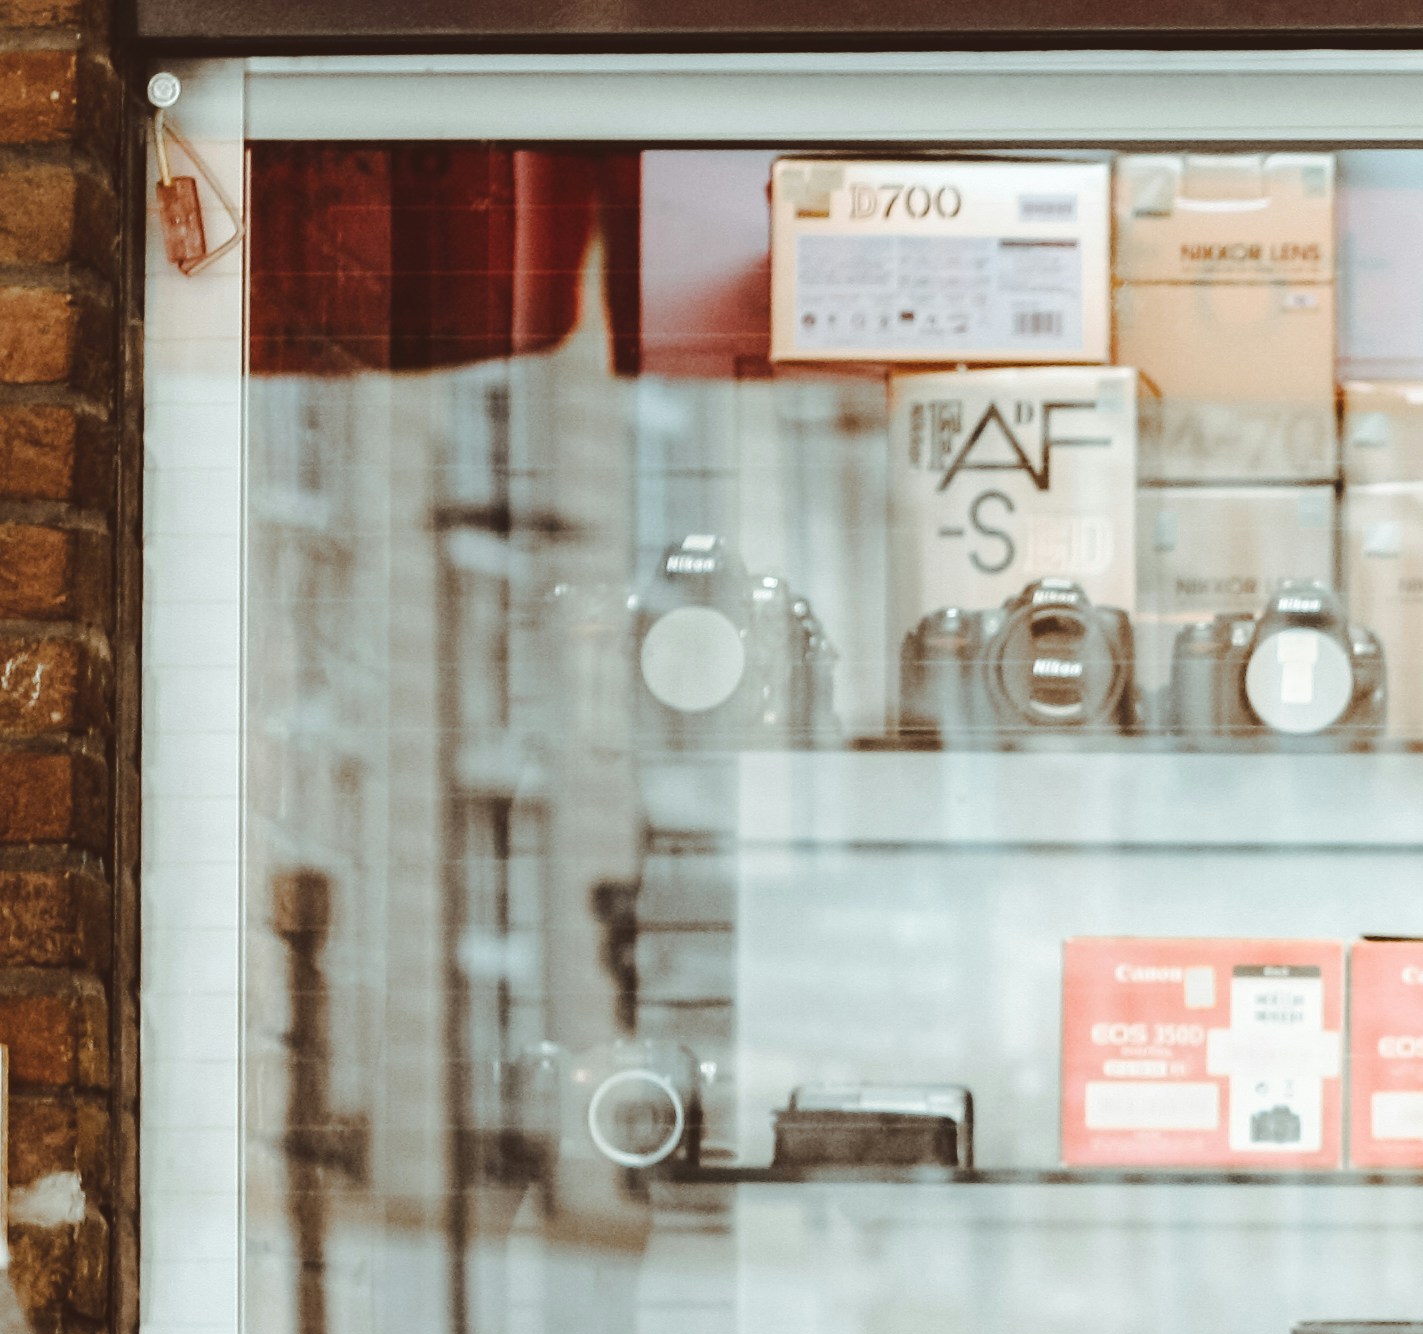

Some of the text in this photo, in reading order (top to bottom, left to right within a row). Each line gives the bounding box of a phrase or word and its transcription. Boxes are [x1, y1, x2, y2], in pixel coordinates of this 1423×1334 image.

[849, 183, 963, 220] D700
[1180, 243, 1321, 261] NIKKOR LENS
[1032, 658, 1083, 678] Nikon
[1114, 963, 1185, 983] Canon
[1091, 1022, 1149, 1046] EOS
